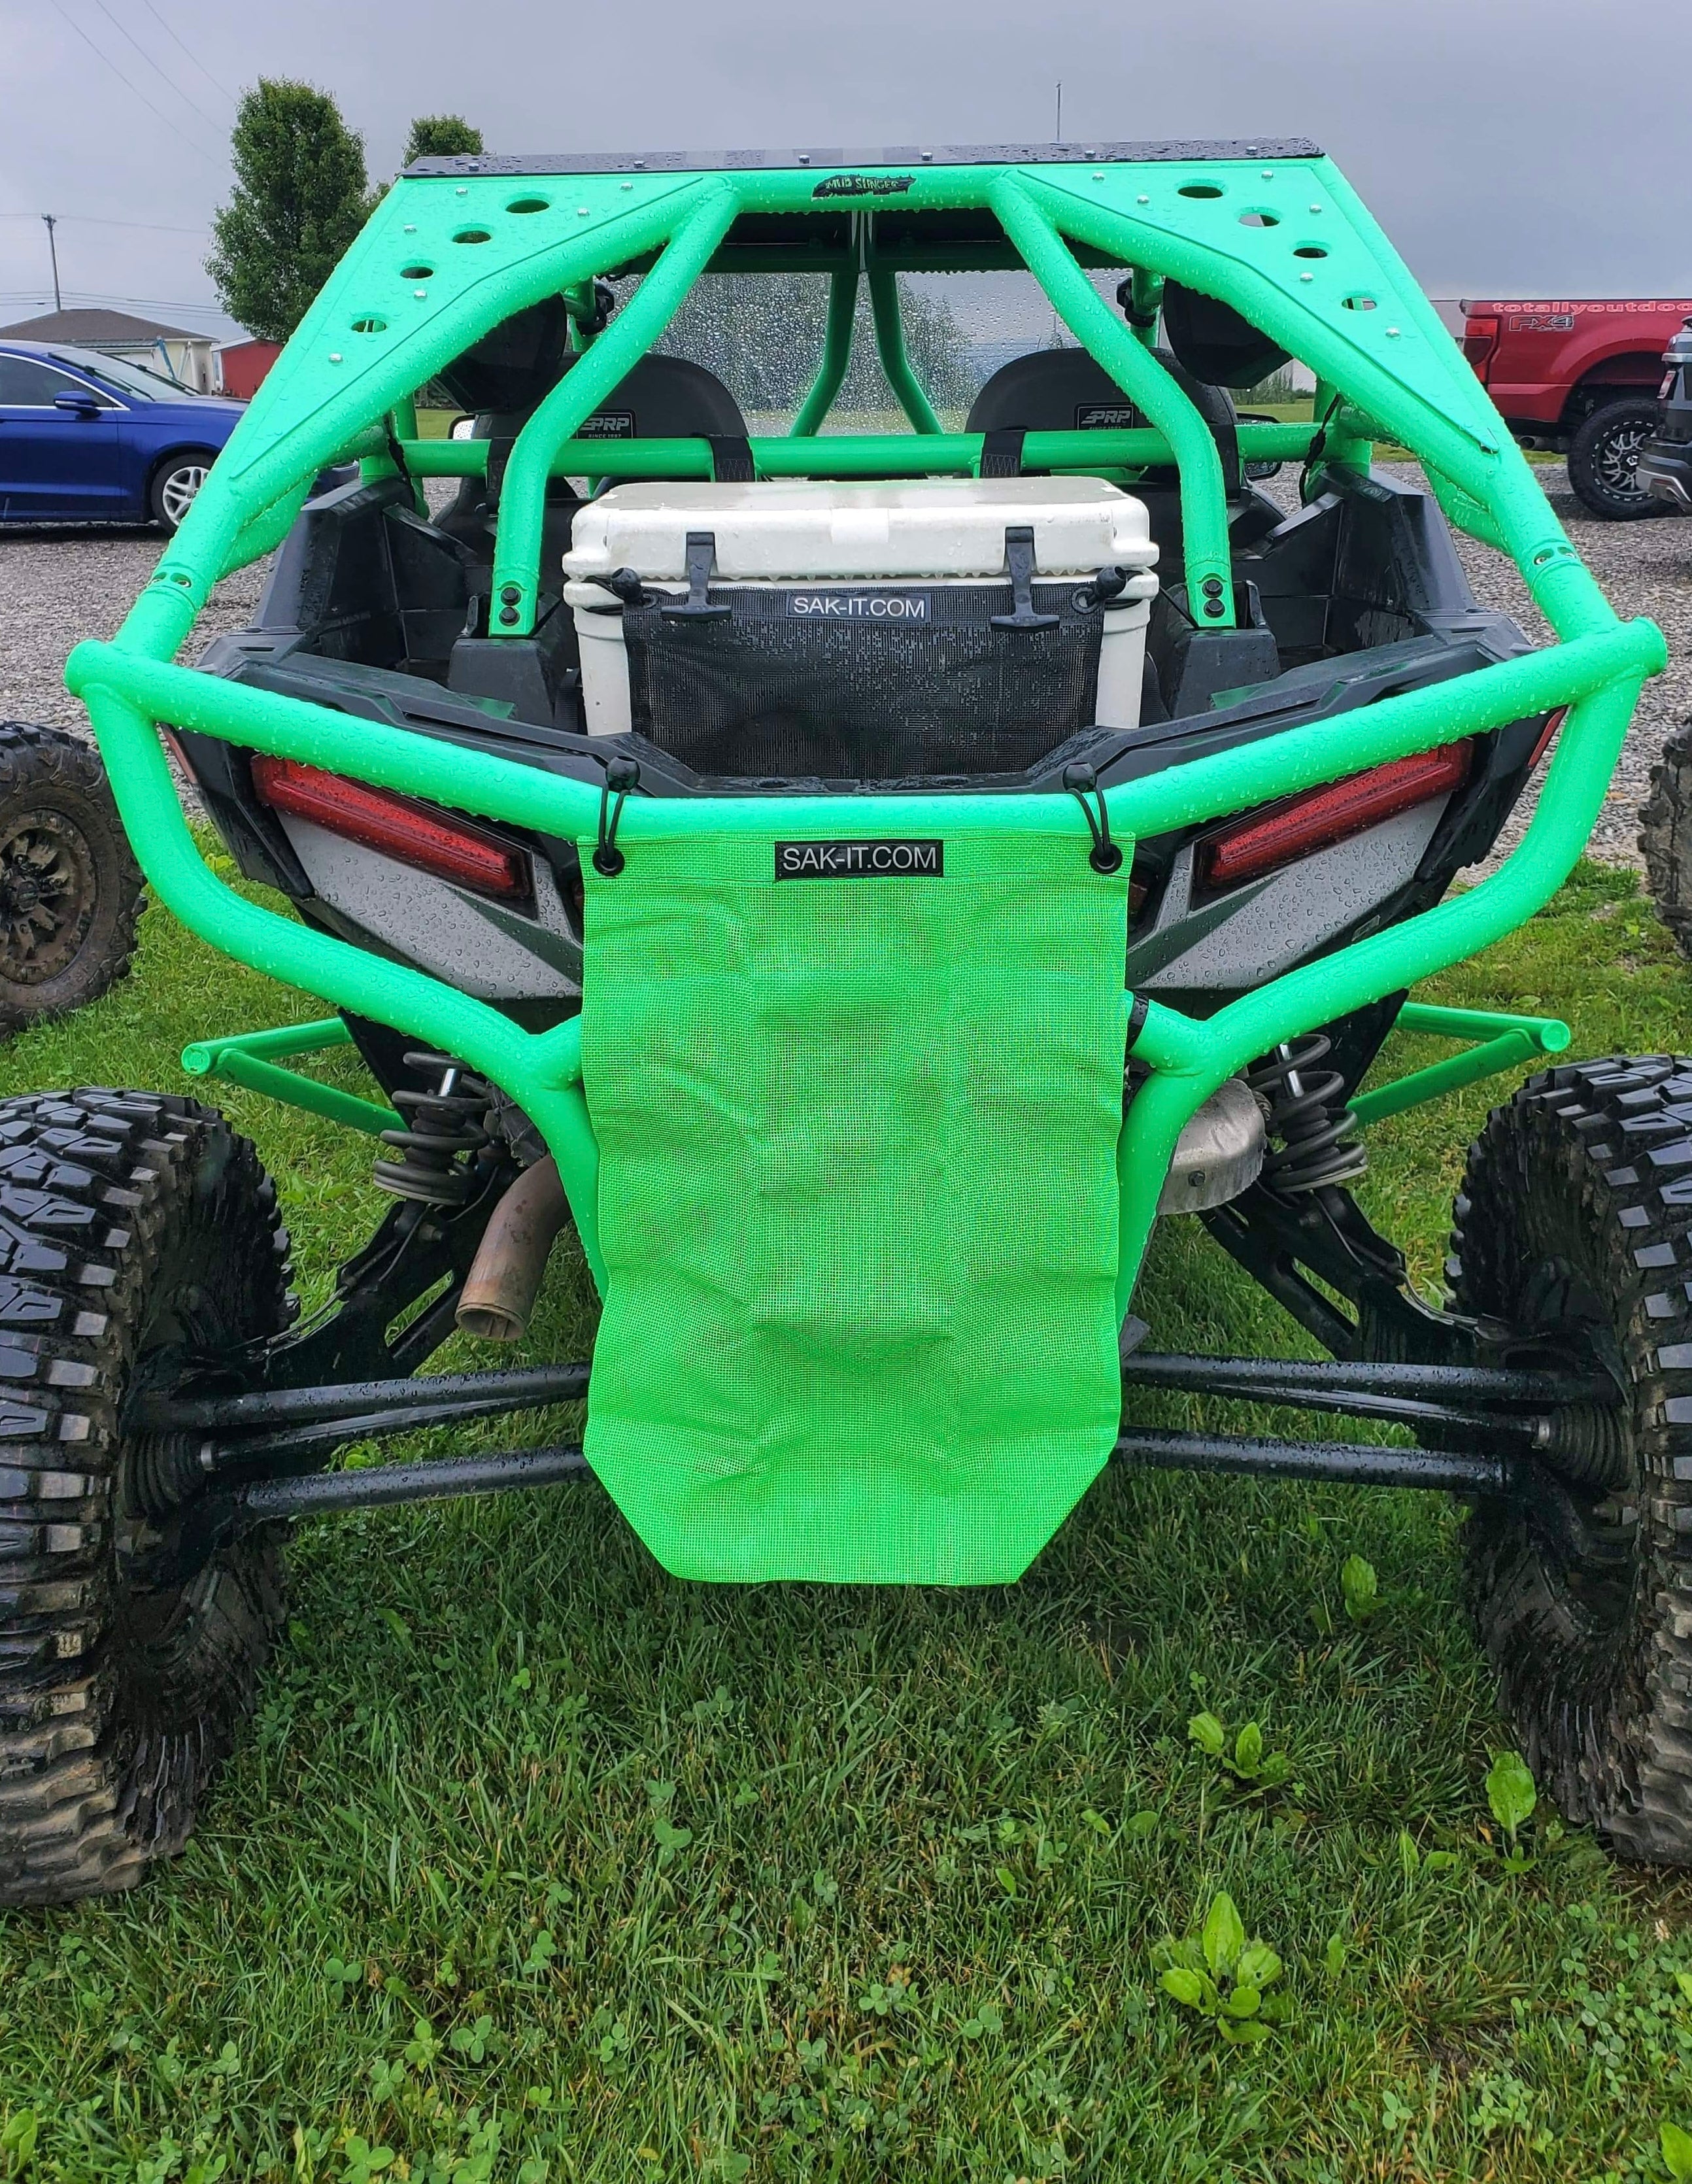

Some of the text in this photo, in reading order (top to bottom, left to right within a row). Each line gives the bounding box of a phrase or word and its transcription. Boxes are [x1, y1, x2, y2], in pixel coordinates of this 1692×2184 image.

[825, 177, 853, 189] MUD
[1508, 315, 1574, 332] FX4
[580, 417, 630, 431] PRP
[1081, 410, 1131, 424] PRP
[794, 597, 924, 619] SAK-IT.COM
[783, 846, 936, 870] SAK-IT.COM
